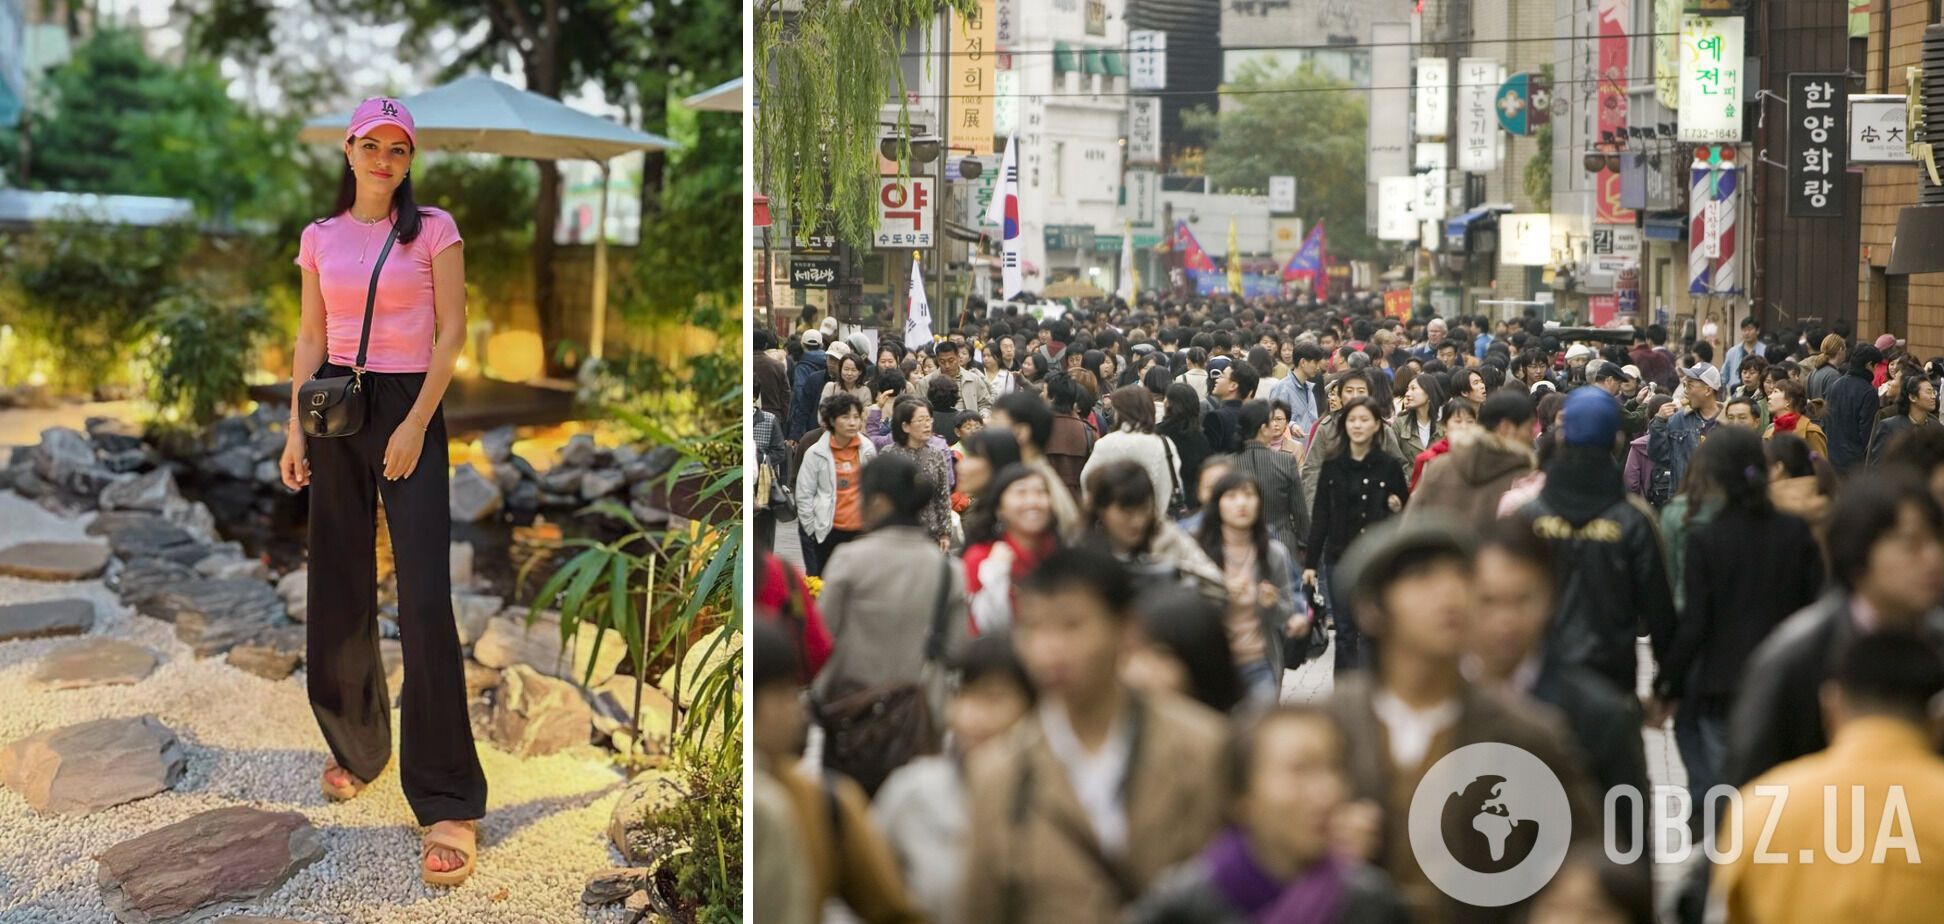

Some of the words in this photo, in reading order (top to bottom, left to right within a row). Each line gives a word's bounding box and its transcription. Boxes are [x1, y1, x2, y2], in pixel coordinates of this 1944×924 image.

[1696, 36, 1721, 95] 예전
[382, 100, 398, 117] LA
[1468, 66, 1488, 157] 나누는기쁨
[1724, 69, 1736, 118] 커피숍
[962, 108, 981, 129] 展
[1803, 82, 1835, 208] 한양화랑
[881, 182, 928, 231] 약
[879, 234, 929, 245] 수도약국
